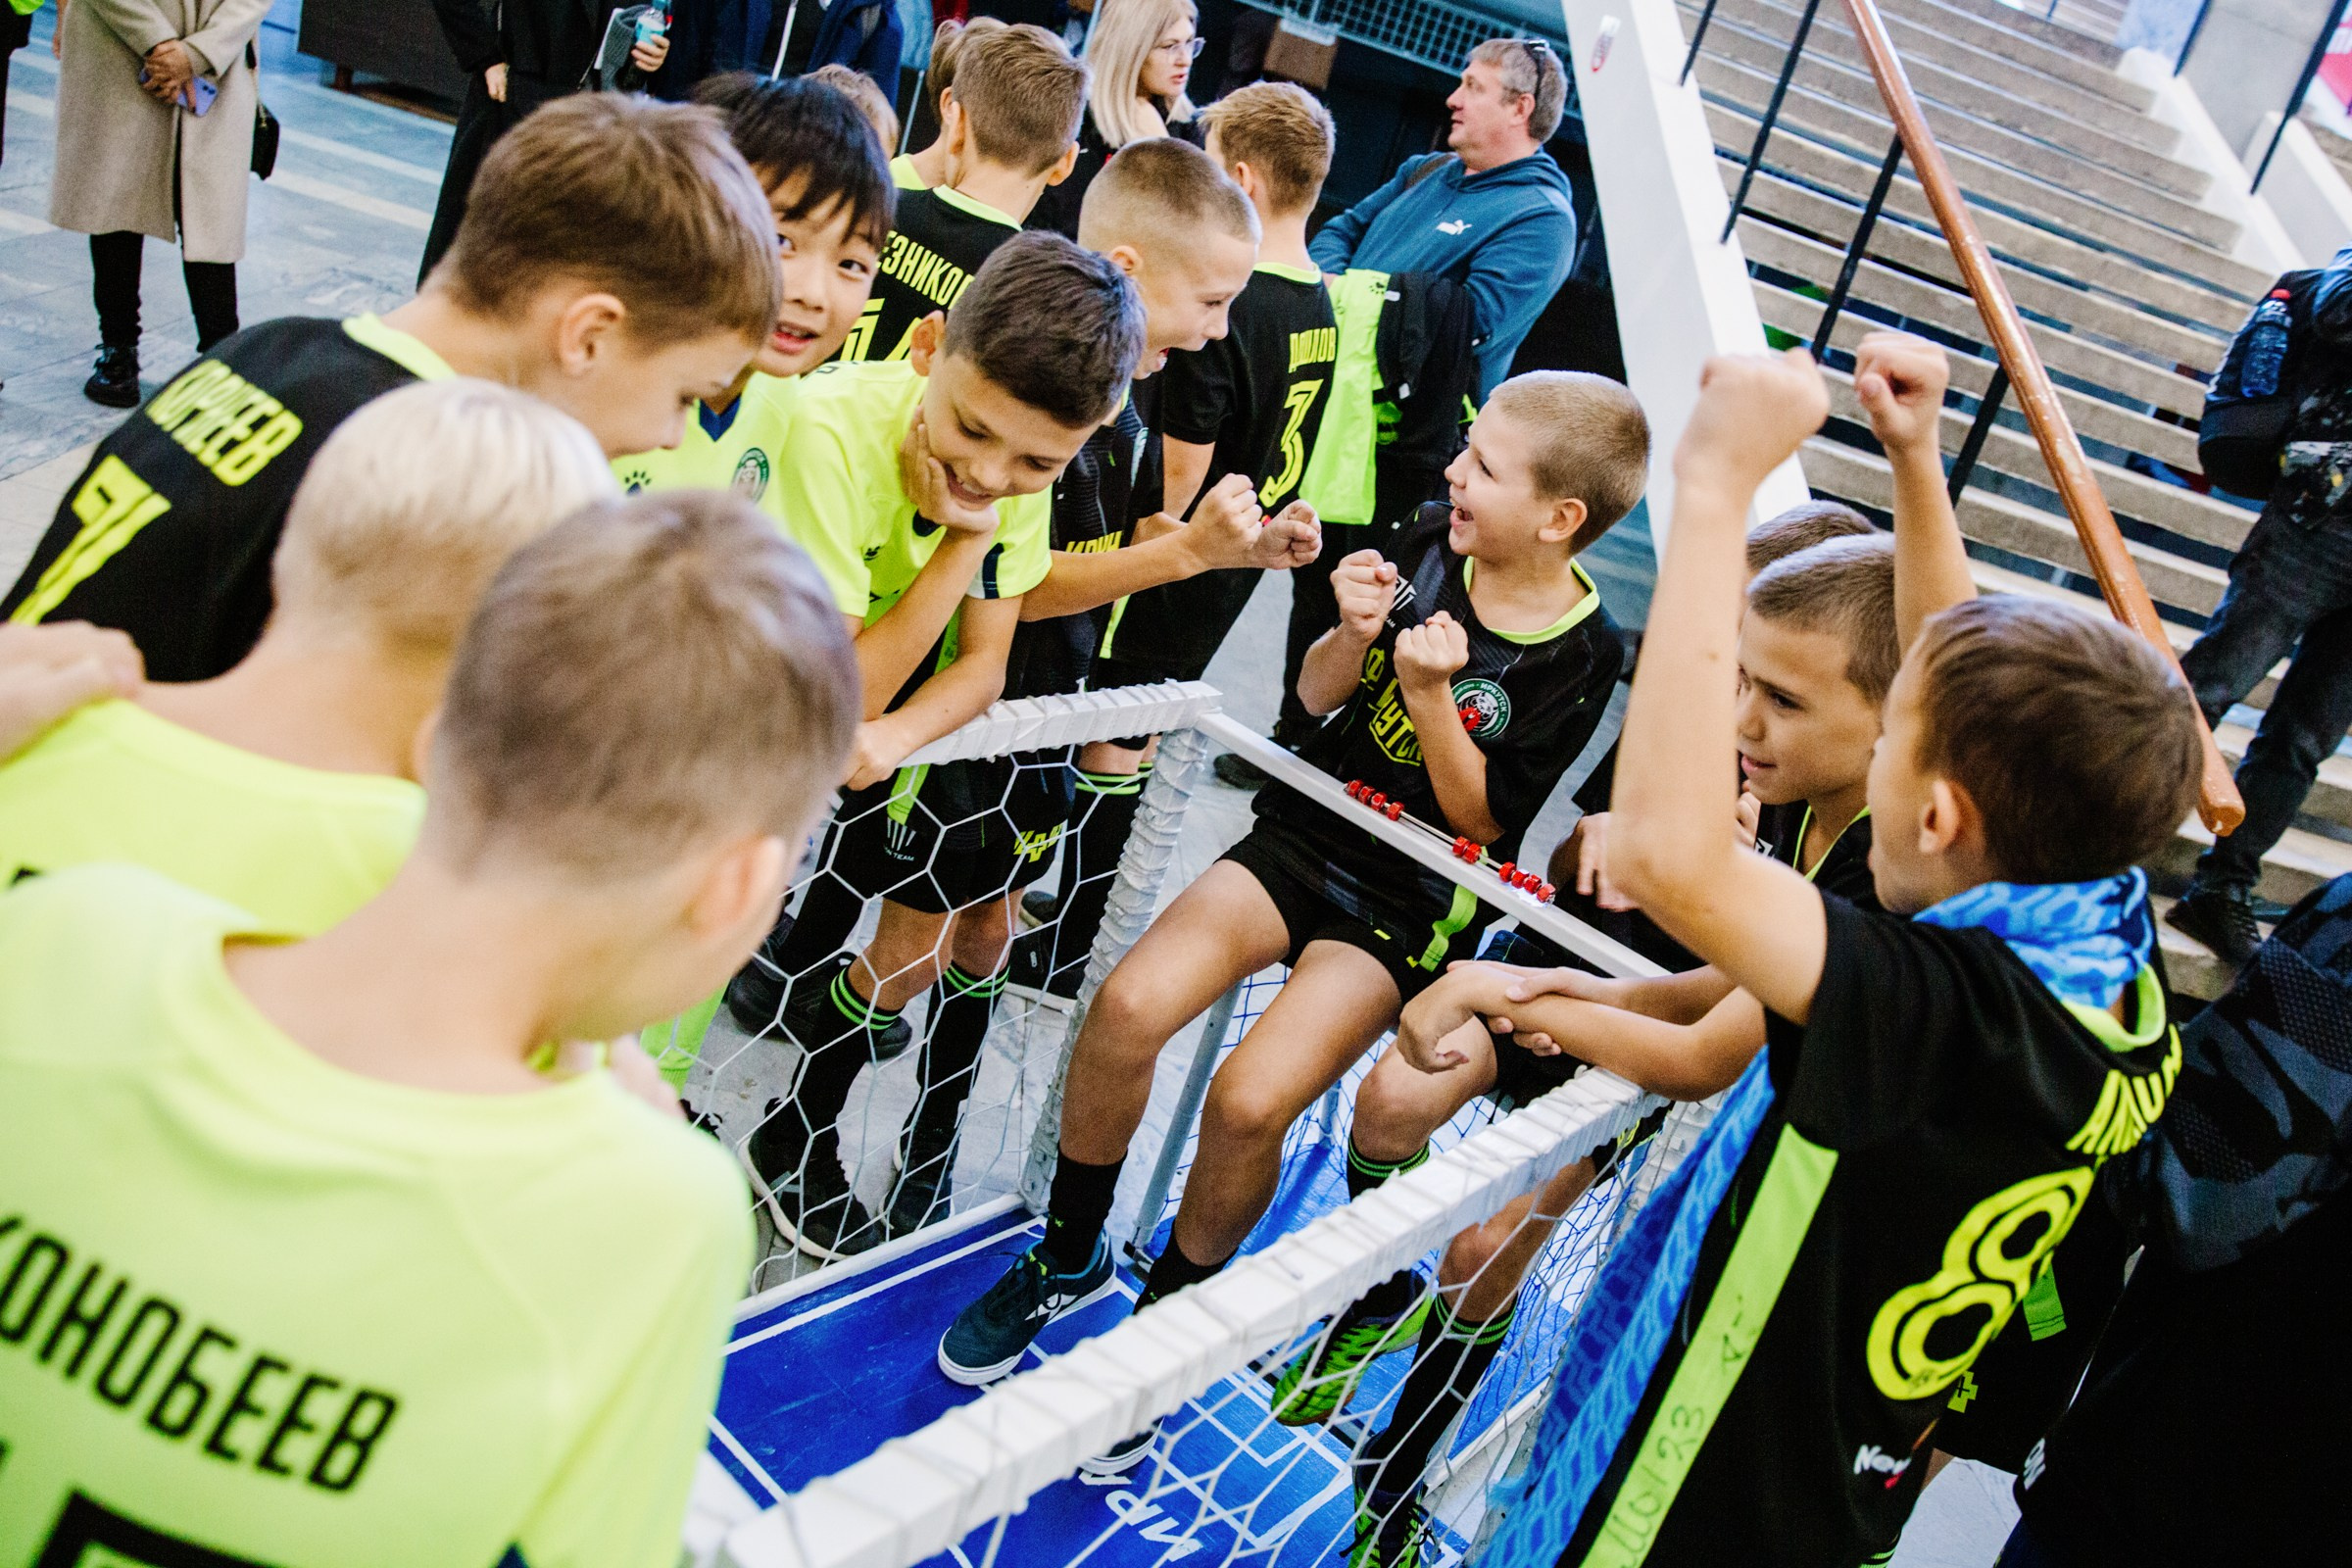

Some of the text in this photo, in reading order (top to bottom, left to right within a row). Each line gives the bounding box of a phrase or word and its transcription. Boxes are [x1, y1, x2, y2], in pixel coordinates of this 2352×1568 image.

[1258, 378, 1324, 508] 3
[10, 454, 172, 625] 7
[1480, 682, 1508, 712] ИРКУТСК
[0, 1216, 403, 1494] ОНОБЕЕВ
[1866, 1166, 2095, 1400] 8
